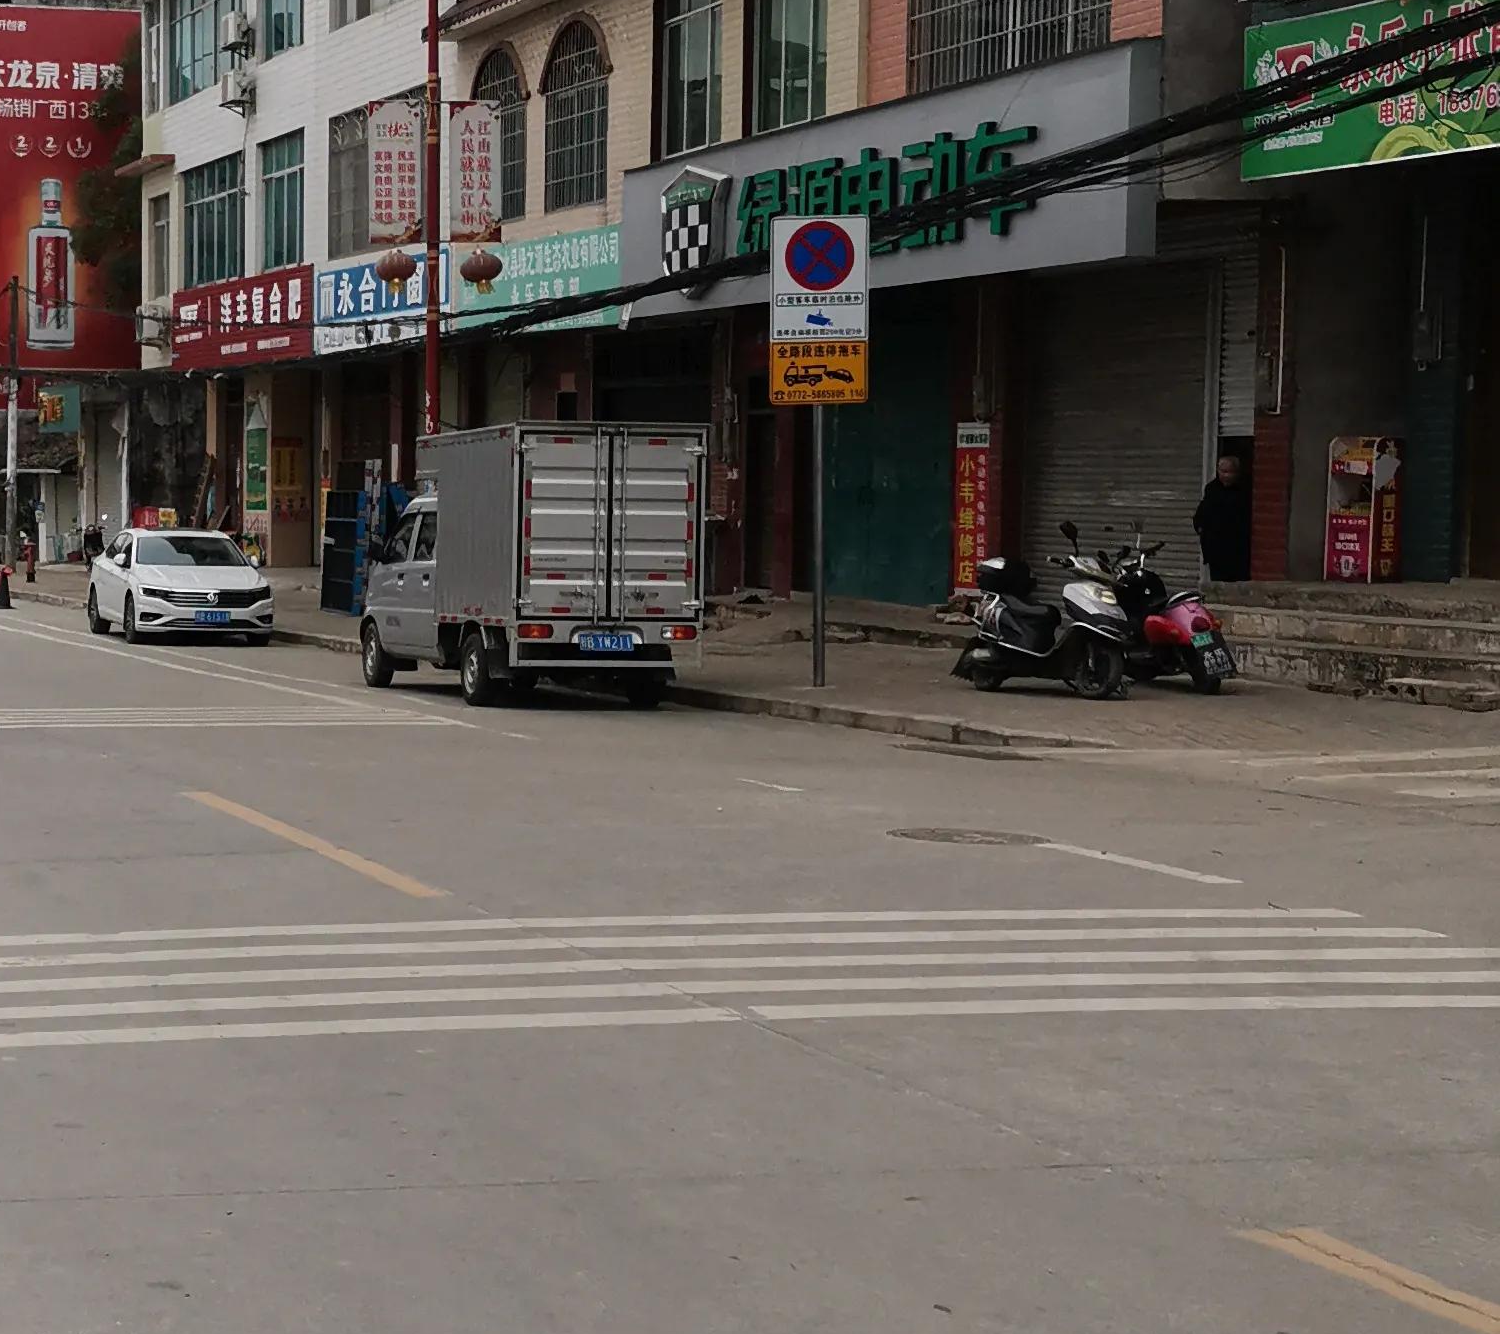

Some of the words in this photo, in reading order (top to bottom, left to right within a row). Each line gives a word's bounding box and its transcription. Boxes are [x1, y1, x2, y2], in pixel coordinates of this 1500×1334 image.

[736, 121, 1037, 257] 绿源电动车
[777, 345, 861, 359] 全路段违停拖车
